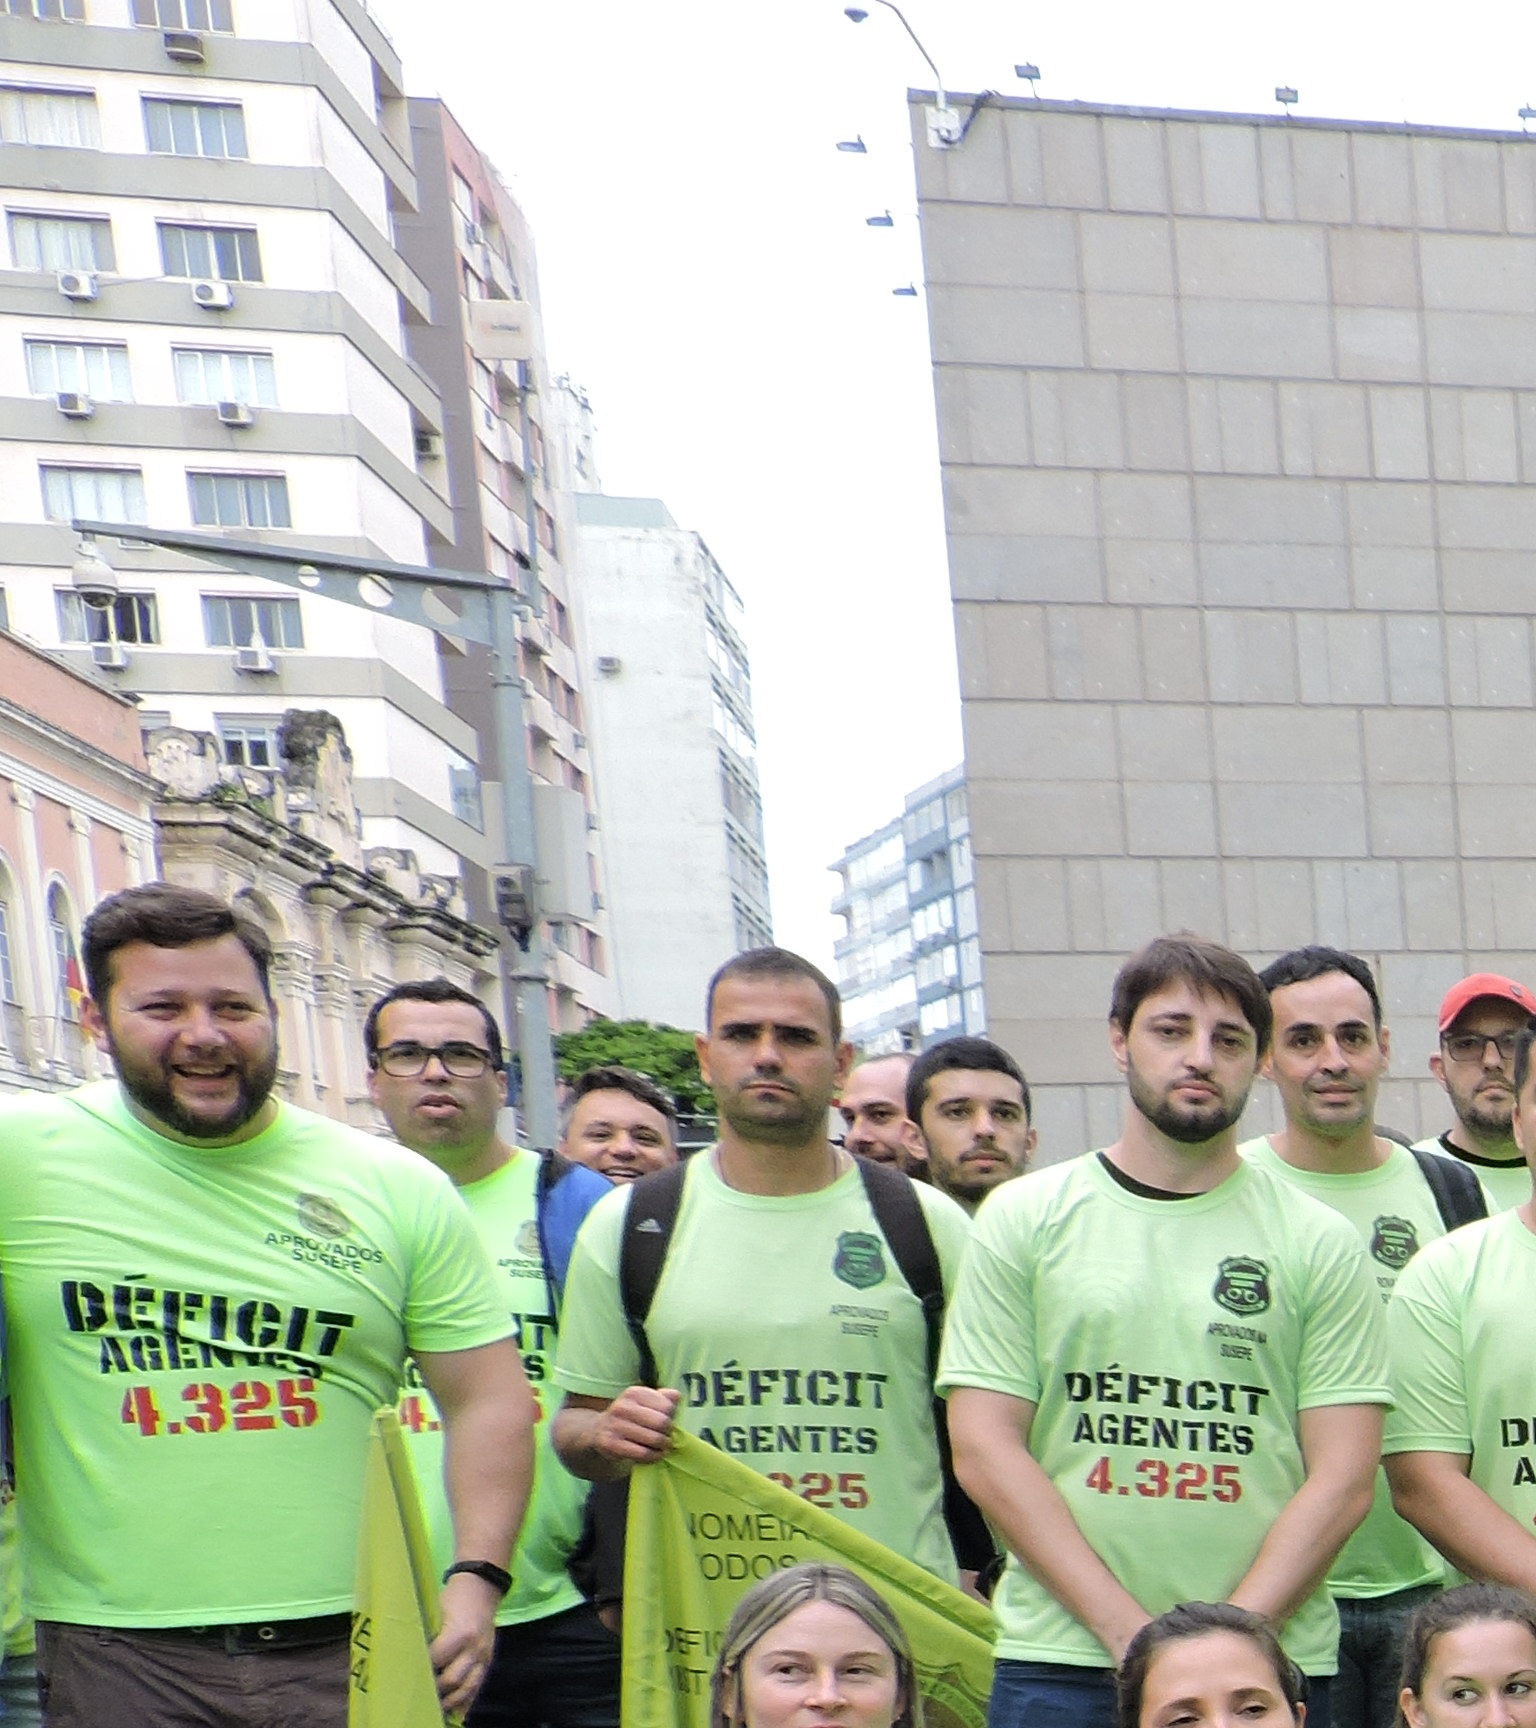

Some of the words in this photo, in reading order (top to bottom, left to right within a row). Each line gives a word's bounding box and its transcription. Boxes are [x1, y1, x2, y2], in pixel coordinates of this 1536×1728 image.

[265, 1232, 384, 1264] APROVADOS
[292, 1247, 363, 1274] SUSEPE
[60, 1273, 356, 1357] DÉFICIT
[121, 1378, 319, 1437] 4.325
[682, 1360, 889, 1410] DÉFICIT
[1064, 1363, 1270, 1417] DÉFICIT
[700, 1424, 878, 1455] AGENTES
[1072, 1412, 1255, 1456] AGENTES
[1085, 1456, 1243, 1504] 4.325
